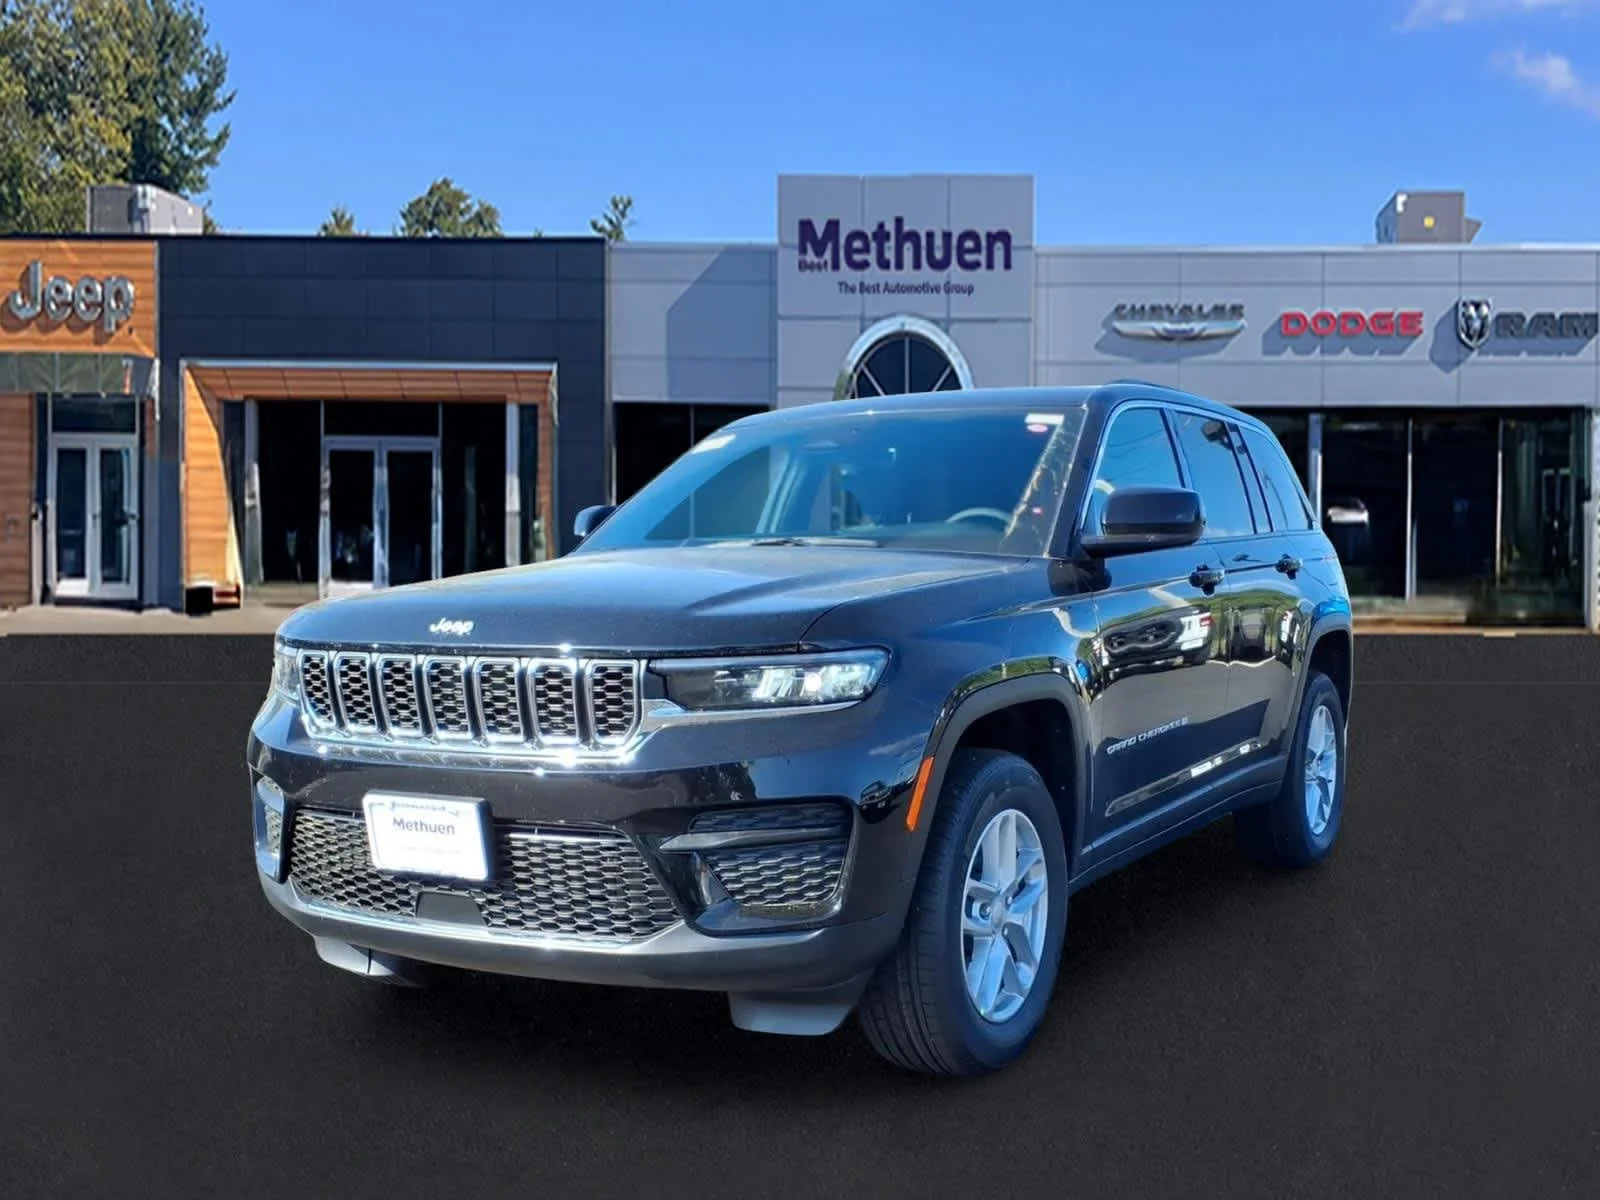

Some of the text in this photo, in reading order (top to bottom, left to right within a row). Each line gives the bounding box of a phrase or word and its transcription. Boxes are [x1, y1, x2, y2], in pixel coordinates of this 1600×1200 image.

[797, 217, 1013, 272] Methuen
[8, 260, 135, 333] Jeep
[838, 281, 975, 295] The Best Automotive Group
[1281, 311, 1425, 336] DODGE
[1495, 311, 1598, 338] RAM
[429, 616, 475, 636] Jeep
[1106, 736, 1137, 755] GRAND
[392, 816, 456, 836] Methuen
